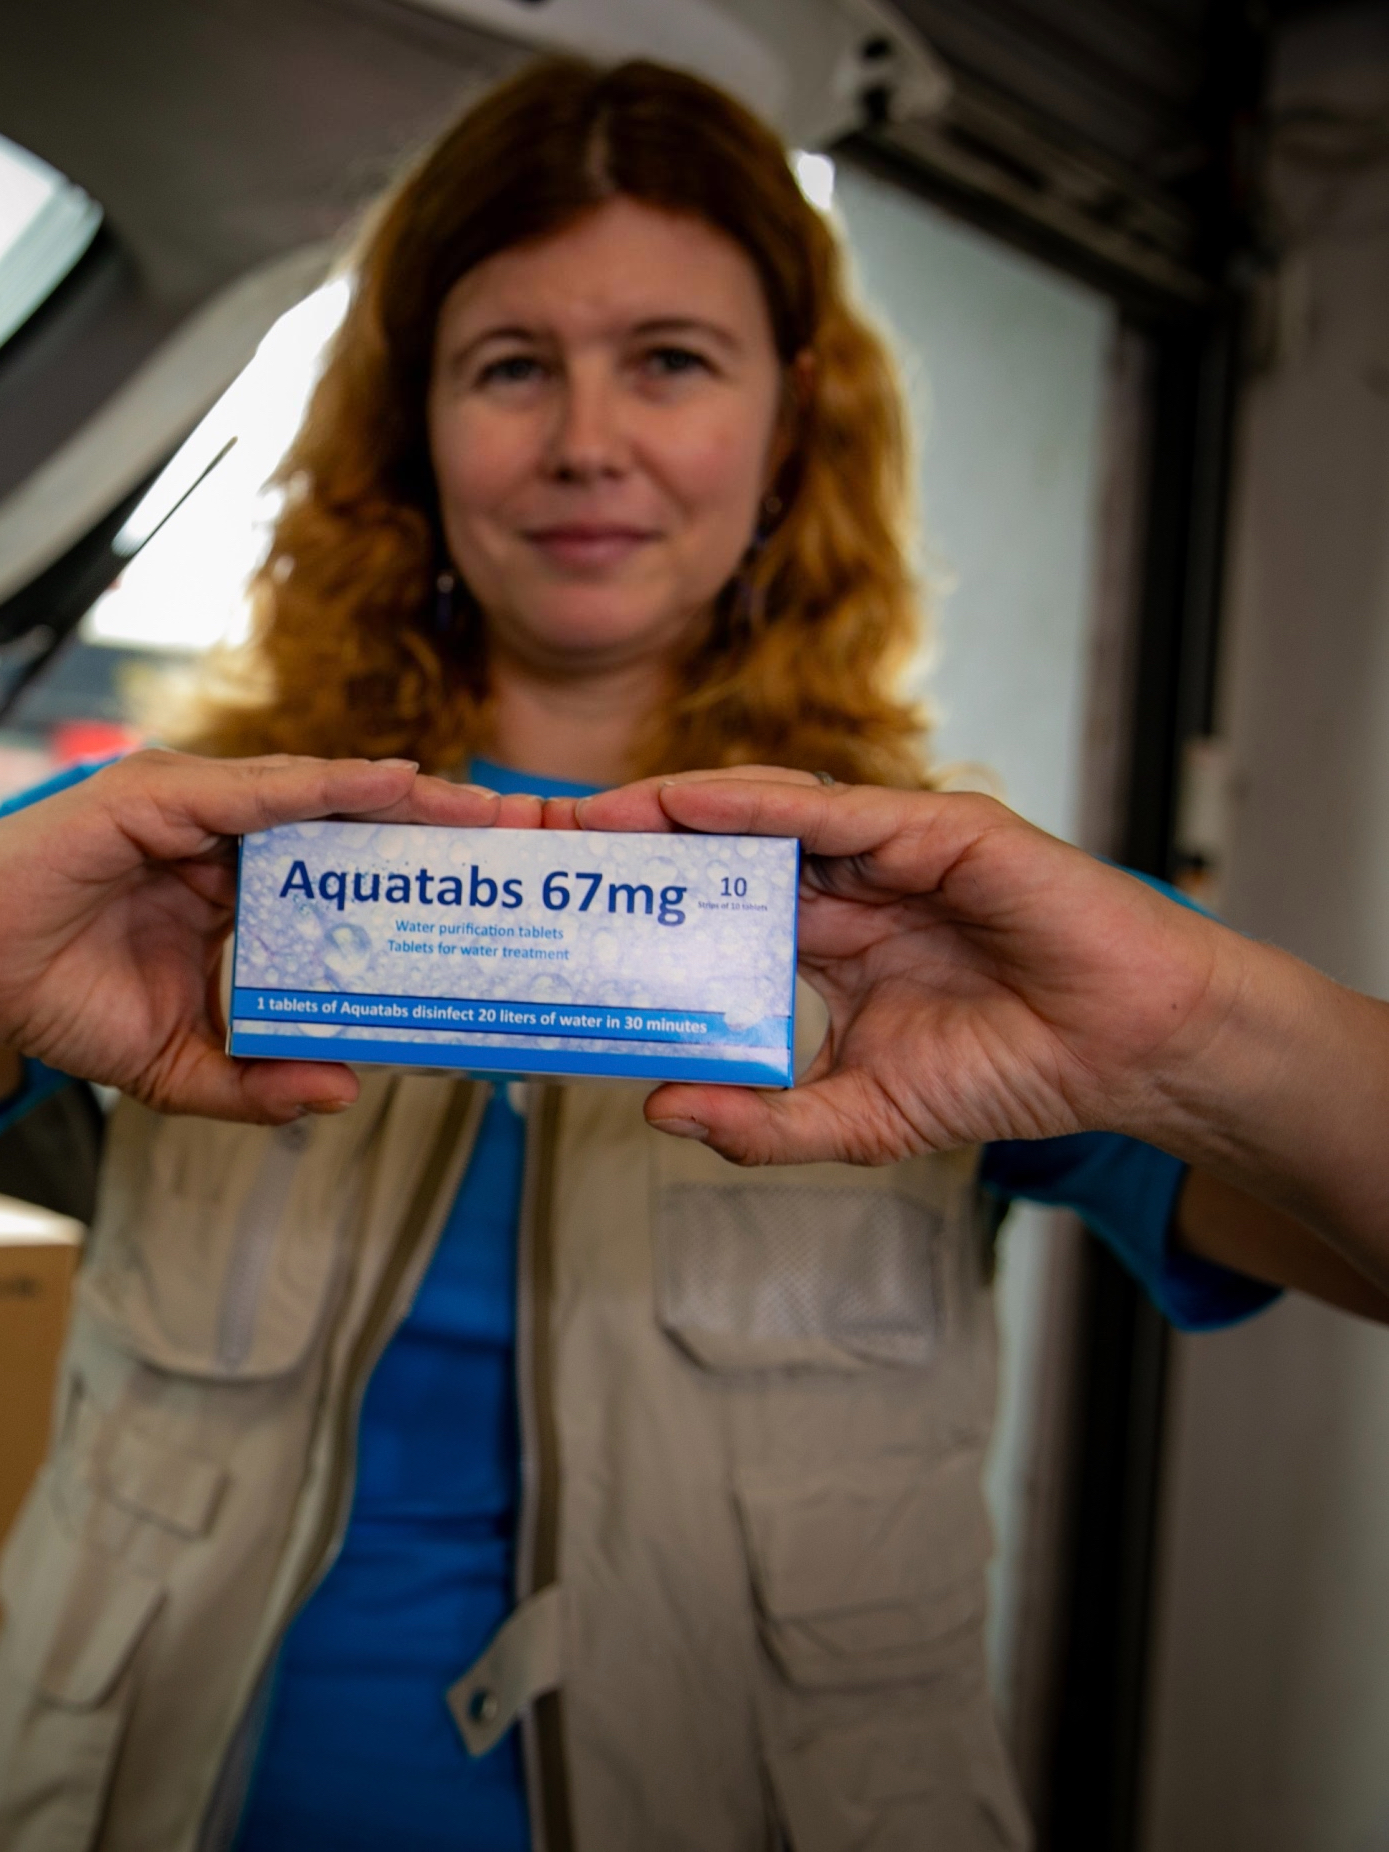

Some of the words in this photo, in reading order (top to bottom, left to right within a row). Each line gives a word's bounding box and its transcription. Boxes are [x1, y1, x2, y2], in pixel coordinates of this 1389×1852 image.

[279, 860, 523, 911] Aquatabs
[542, 870, 687, 926] 67mg
[720, 877, 747, 897] 10
[698, 901, 719, 911] Strips
[721, 901, 729, 910] of
[731, 902, 740, 911] 10
[395, 920, 434, 934] Water
[439, 922, 514, 939] purification
[519, 926, 564, 940] tablets
[387, 939, 434, 955] Tablets
[438, 941, 457, 955] for
[460, 946, 498, 957] water
[502, 947, 570, 961] treatment
[257, 997, 265, 1010] 1
[269, 998, 319, 1013] tablets
[322, 999, 338, 1014] of
[340, 1001, 409, 1018] Aquatabs
[412, 1005, 474, 1021] disinfect
[478, 1008, 497, 1022] 20
[500, 1009, 537, 1024] liters
[540, 1011, 556, 1026] of
[560, 1015, 603, 1029] water
[606, 1014, 620, 1029] in
[624, 1016, 643, 1031] 30
[646, 1018, 708, 1034] minutes
